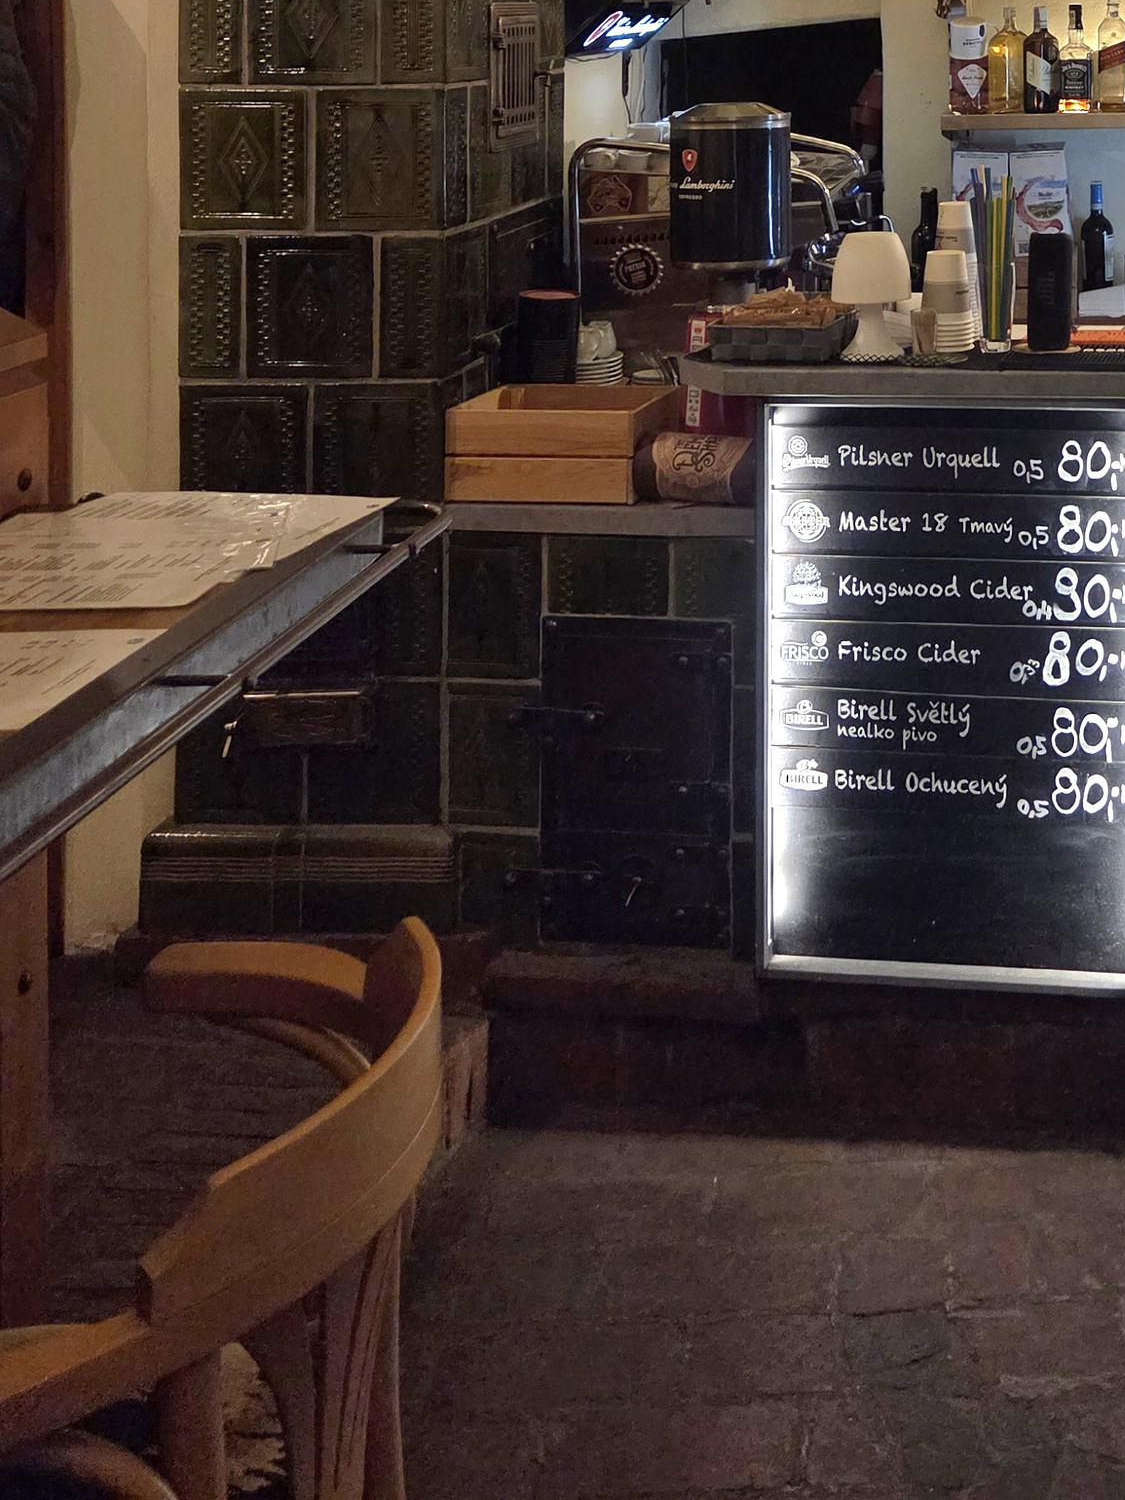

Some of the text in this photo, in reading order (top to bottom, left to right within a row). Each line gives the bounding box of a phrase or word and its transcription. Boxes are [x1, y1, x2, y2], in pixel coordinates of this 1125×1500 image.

[679, 176, 736, 193] Lamborghini
[838, 444, 914, 470] Pilsner
[922, 446, 1001, 480] Urquell
[1013, 459, 1045, 484] 0,5
[838, 512, 912, 533] Master
[921, 512, 949, 533] 18
[958, 517, 1013, 543] Tmavý
[1018, 525, 1049, 550] 0,5
[837, 576, 961, 606] Kingswood
[969, 578, 1034, 602] Cider
[781, 645, 830, 662] FRISCO
[837, 641, 908, 663] Frisco
[917, 641, 981, 666] Cider
[785, 713, 824, 726] BIRELL
[837, 698, 898, 722] Birell
[907, 699, 971, 737] Světlý
[1016, 736, 1047, 760] 0,5
[837, 724, 938, 751] nealko pivo
[785, 774, 824, 785] BIRELL
[834, 769, 895, 792] Birell
[905, 773, 1009, 810] Ochucený
[1017, 798, 1049, 819] 0,5
